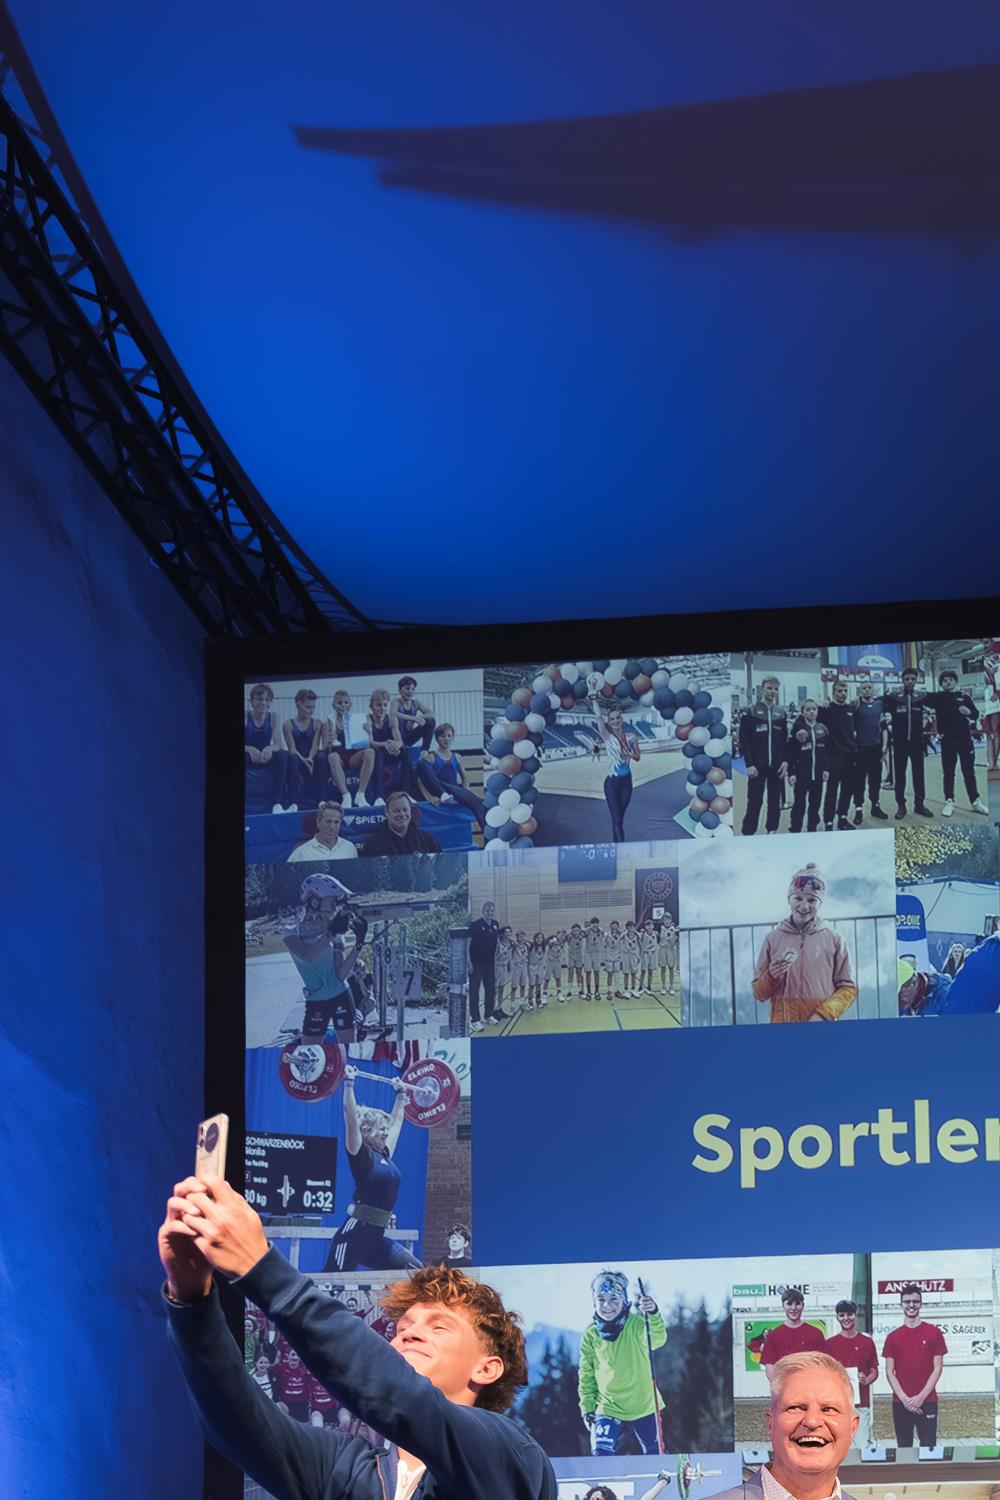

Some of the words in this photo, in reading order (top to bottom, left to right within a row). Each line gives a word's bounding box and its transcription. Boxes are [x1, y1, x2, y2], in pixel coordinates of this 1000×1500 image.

[402, 970, 416, 996] 7
[407, 1063, 436, 1081] ELEIKO
[256, 1193, 267, 1207] kg
[303, 1190, 333, 1208] 0:32
